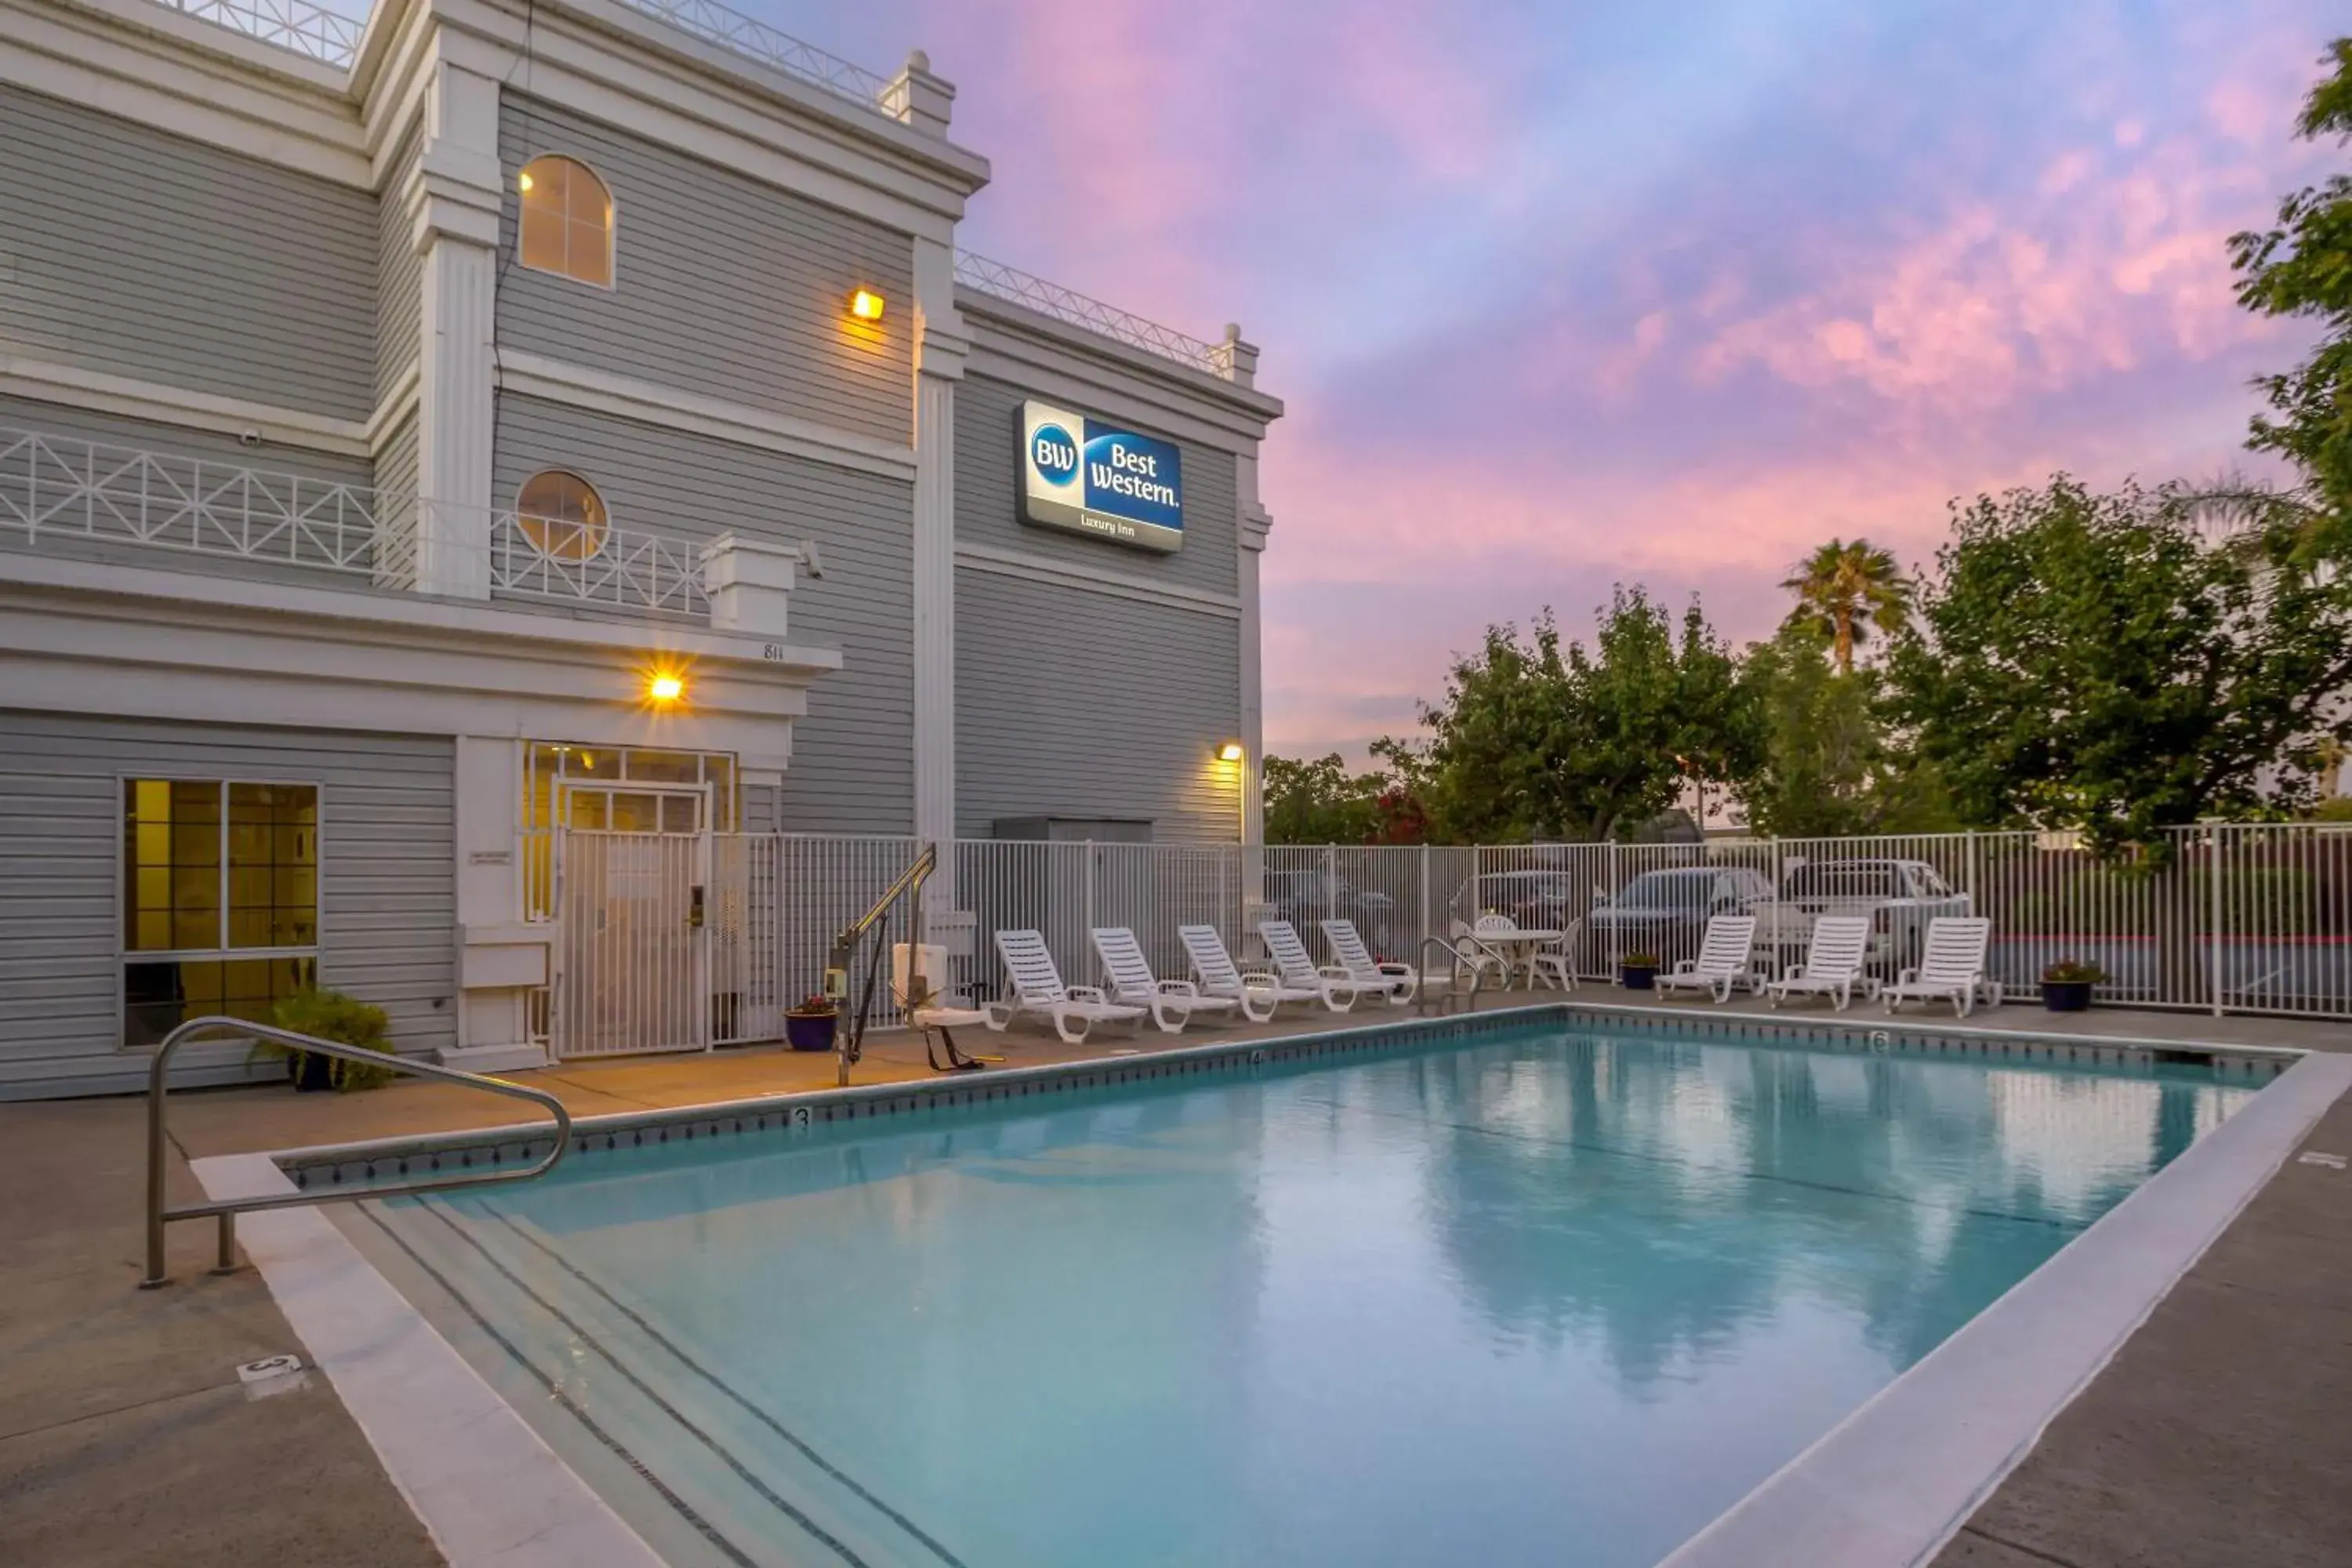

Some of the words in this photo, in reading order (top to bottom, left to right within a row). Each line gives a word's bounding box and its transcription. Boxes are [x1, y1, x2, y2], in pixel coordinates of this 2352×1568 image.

[1036, 439, 1074, 471] BW
[1112, 443, 1156, 477] Best
[1081, 514, 1116, 534] Luxury
[1118, 523, 1134, 537] Inn
[764, 643, 783, 660] 811
